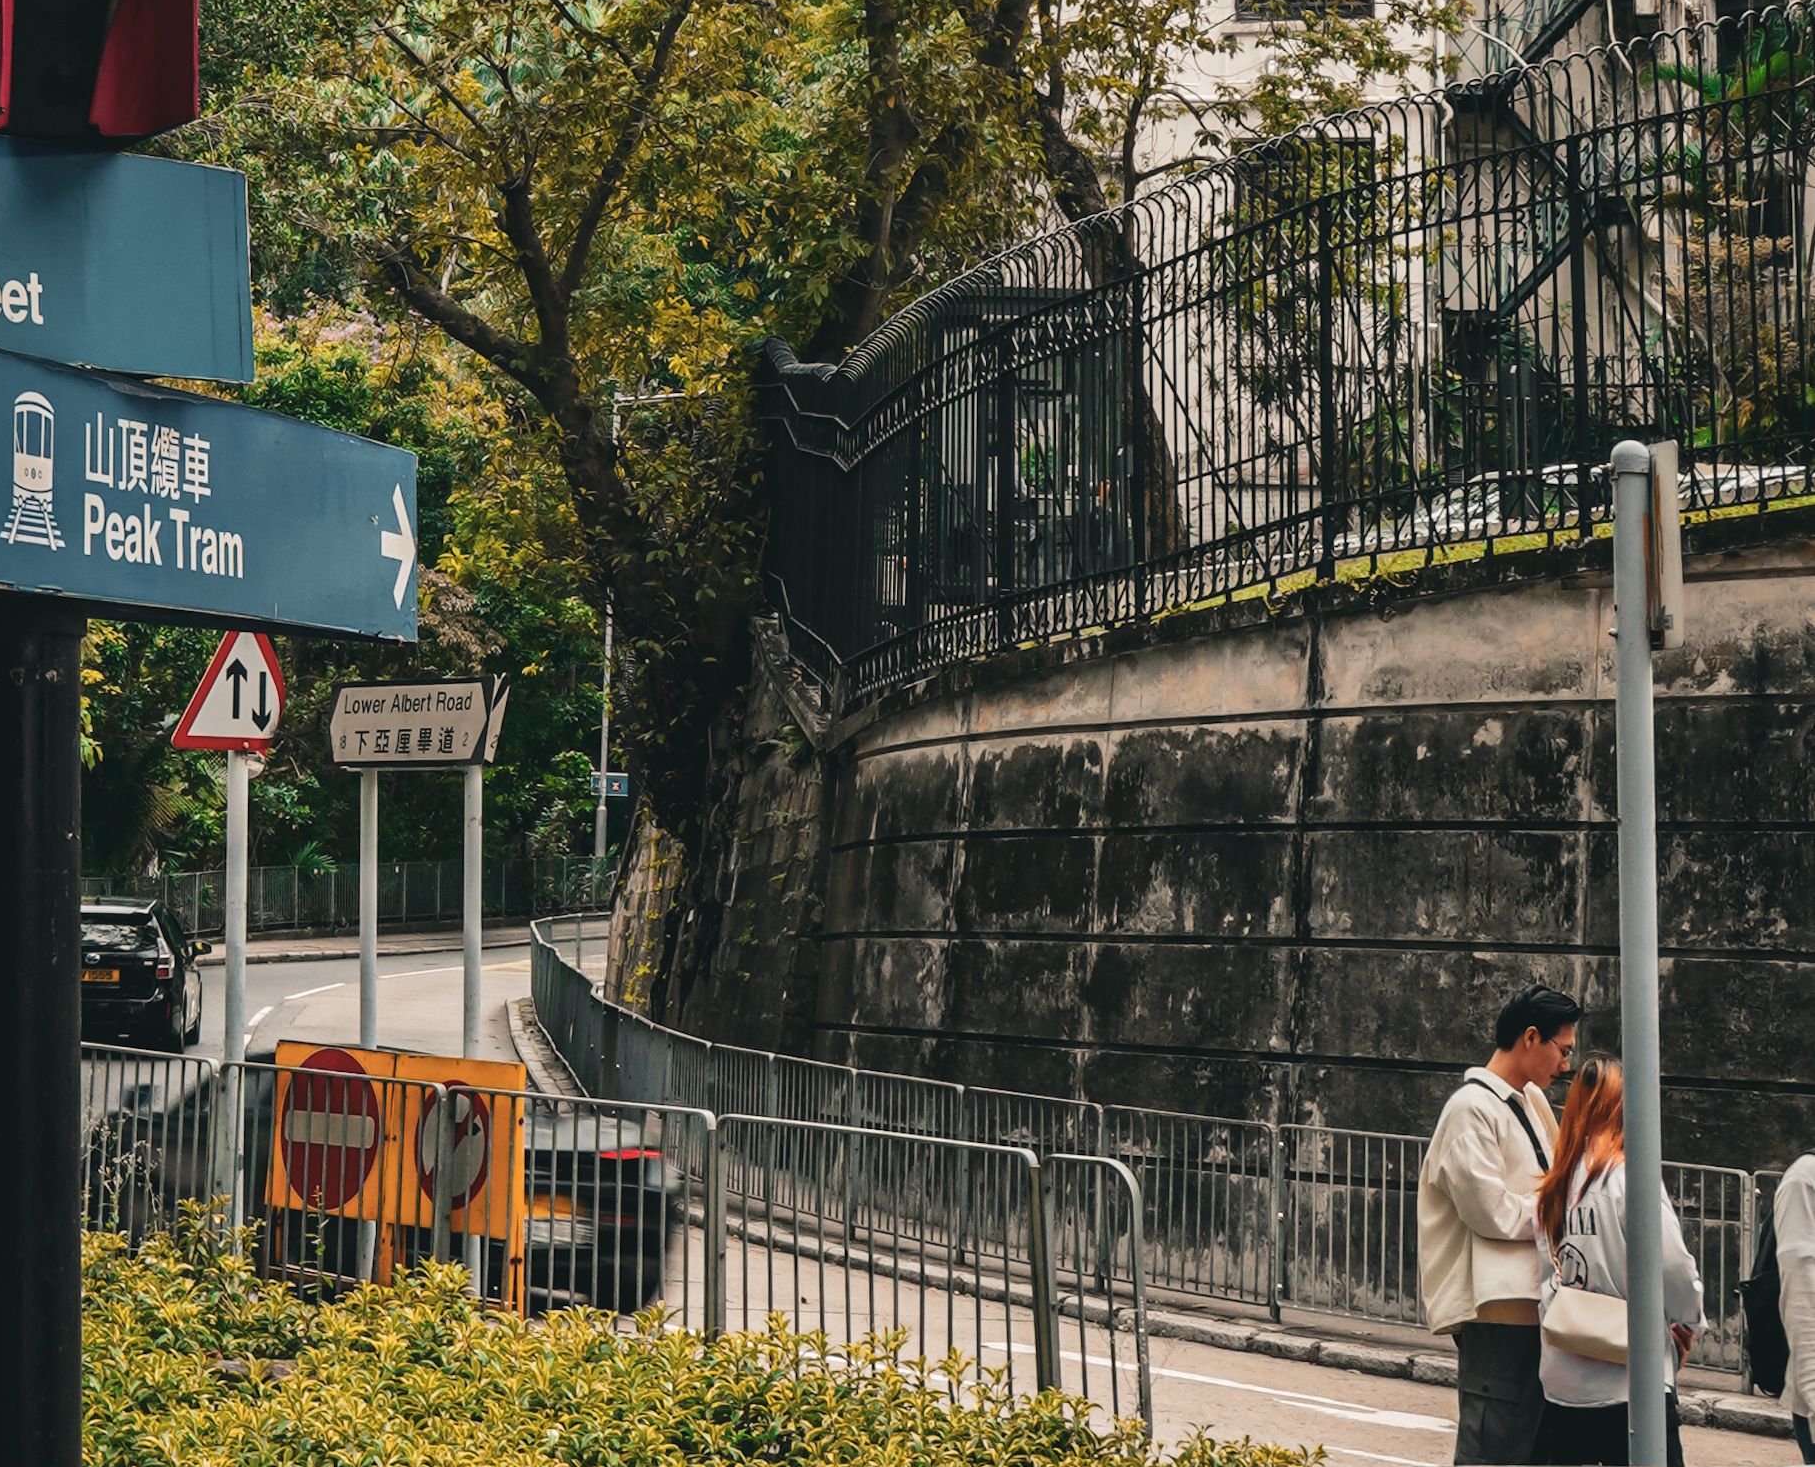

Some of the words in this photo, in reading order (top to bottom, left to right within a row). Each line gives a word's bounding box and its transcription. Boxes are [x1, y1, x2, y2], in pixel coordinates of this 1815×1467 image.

[85, 411, 212, 505] 山頂纜車
[83, 492, 163, 567] Peak
[169, 507, 245, 579] Tram
[344, 694, 386, 715] Lower
[390, 692, 432, 714] Albert
[436, 691, 473, 712] Road
[354, 725, 455, 755] 下亞厘畢道
[462, 731, 469, 747] 2
